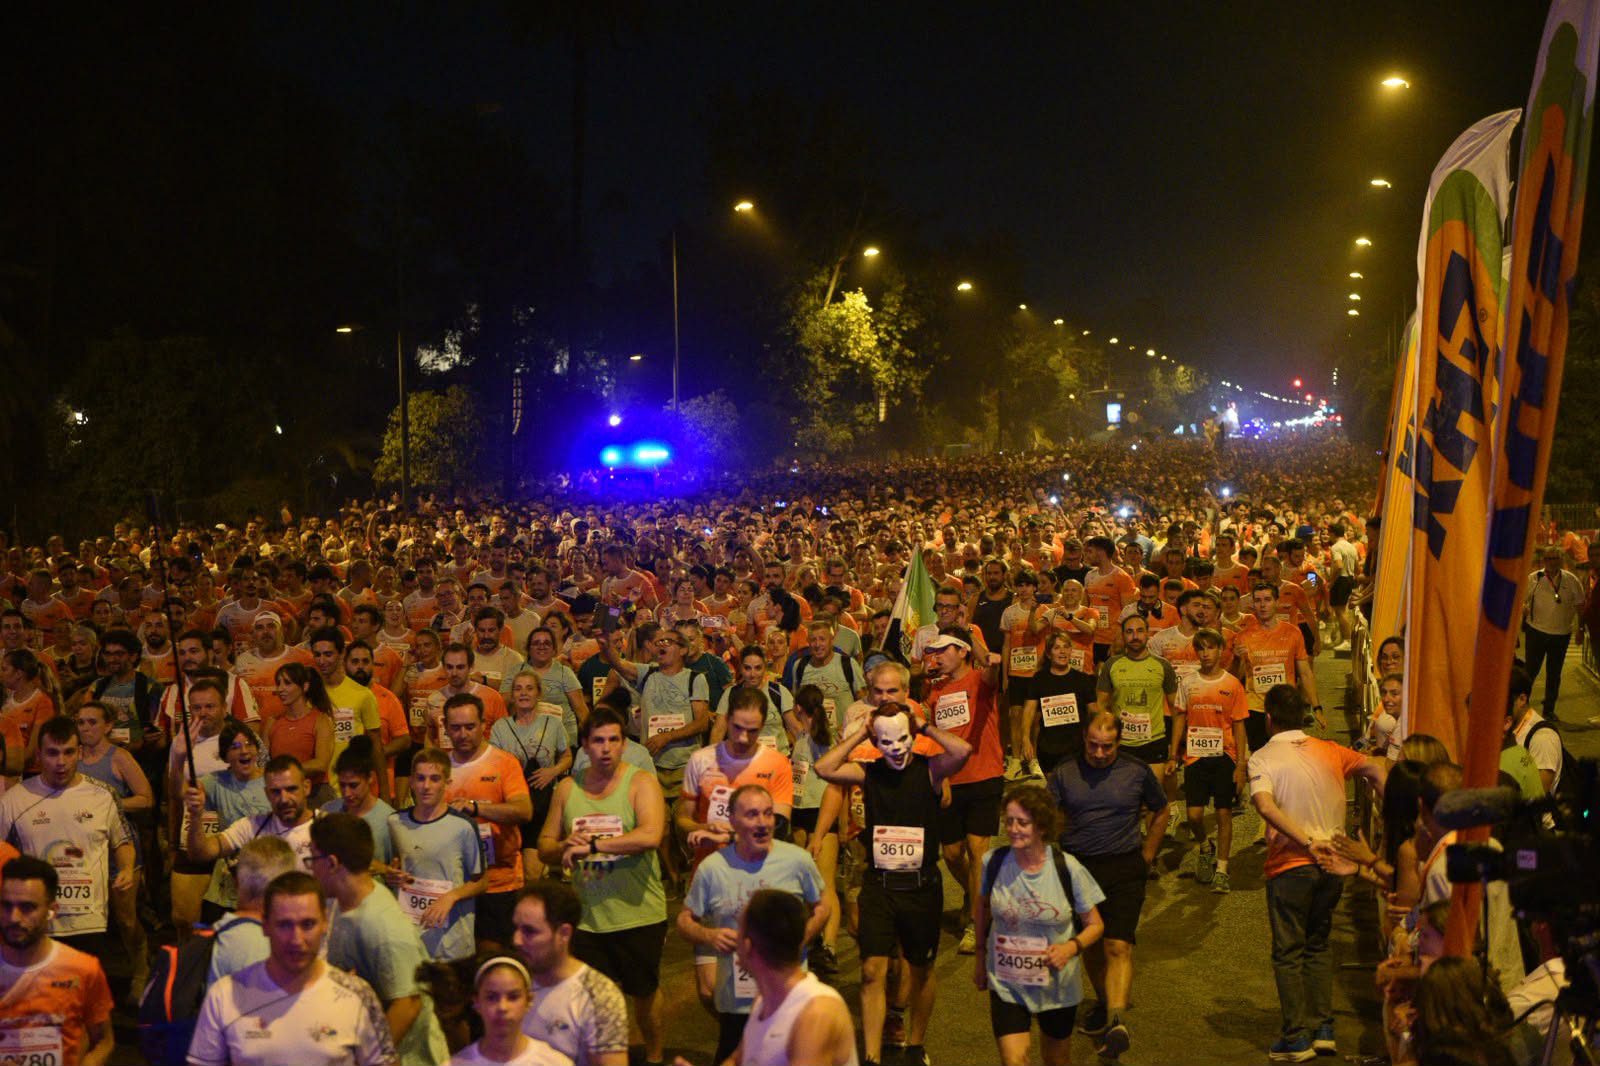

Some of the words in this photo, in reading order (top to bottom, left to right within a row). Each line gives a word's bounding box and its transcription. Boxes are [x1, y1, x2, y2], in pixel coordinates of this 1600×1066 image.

[1255, 674, 1282, 685] 19571
[936, 704, 966, 721] 23058
[1045, 705, 1075, 717] 14820
[1190, 738, 1220, 749] 14817
[880, 843, 915, 857] 3610
[998, 952, 1043, 970] 24054
